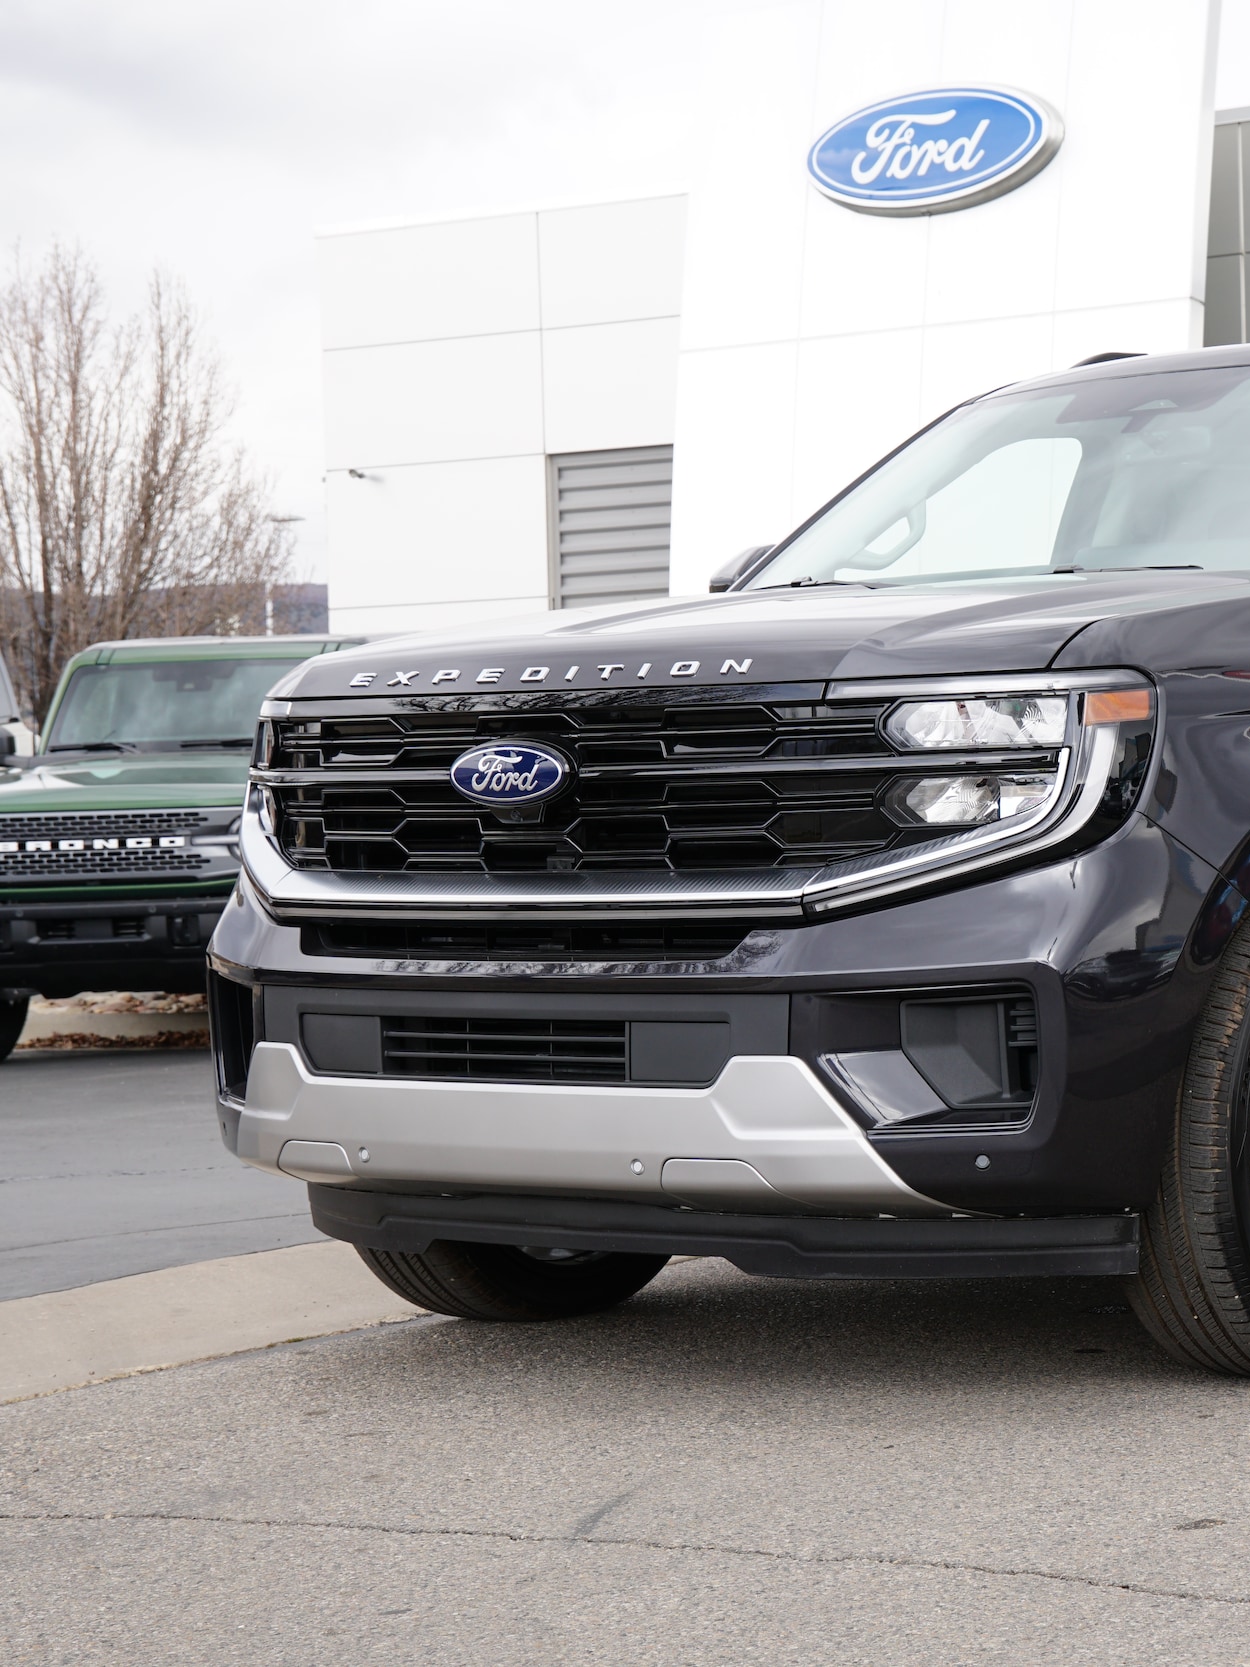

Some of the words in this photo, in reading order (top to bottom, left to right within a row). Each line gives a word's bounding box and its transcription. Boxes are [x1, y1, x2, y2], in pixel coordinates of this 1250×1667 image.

[851, 109, 991, 185] Ford
[349, 658, 753, 688] EXPEDITION
[471, 754, 540, 793] Ford
[0, 836, 185, 852] BRONCO
